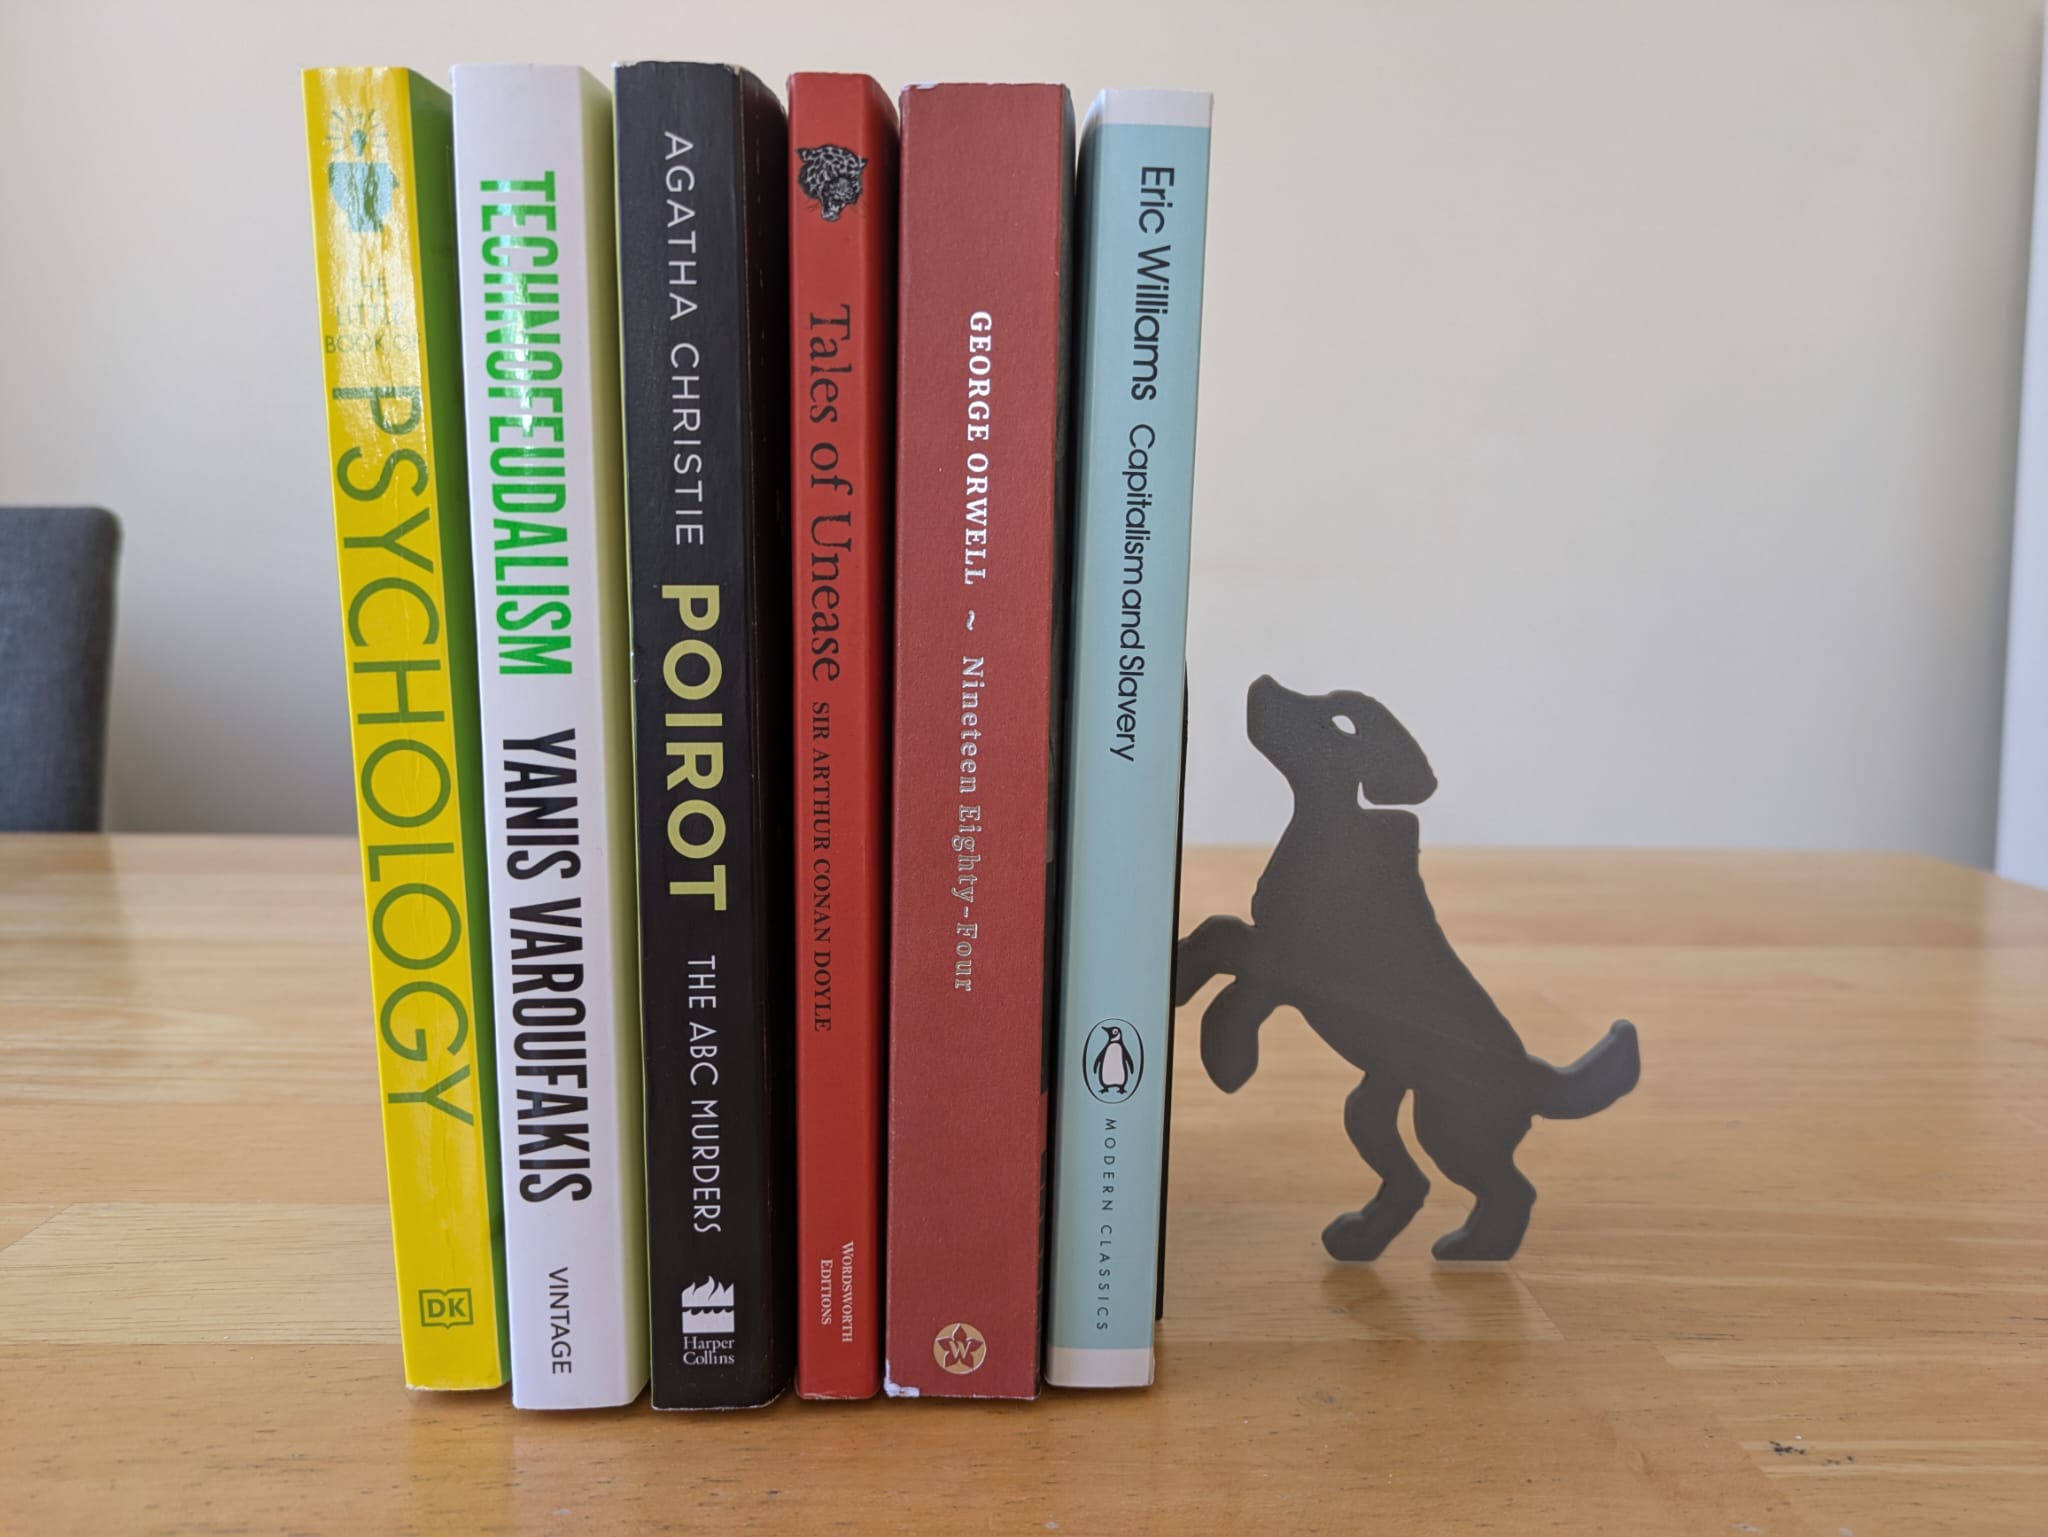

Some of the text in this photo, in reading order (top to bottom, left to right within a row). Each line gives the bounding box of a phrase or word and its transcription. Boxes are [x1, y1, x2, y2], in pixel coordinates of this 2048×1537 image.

[325, 335, 386, 353] BOOK
[664, 131, 704, 546] AGATHA CHRISTIE
[966, 310, 993, 441] GEORGE
[479, 170, 573, 675] TECHNOFEUDALISM
[809, 304, 853, 682] Tales of Unease
[1109, 165, 1176, 762] Eric Williams Capitalism and Slavery
[963, 452, 990, 586] ORWELL
[332, 385, 474, 1127] PSYCHOLOGY
[661, 584, 728, 911] POIROT
[958, 655, 985, 795] Nineteen
[811, 701, 833, 1033] SIR ARTHUR CONAN DOYLE
[950, 804, 982, 993] Eighty-Four
[502, 727, 593, 1204] YANIS VAROUFAKIS
[687, 954, 721, 1234] THE ABC MURDERS
[820, 1258, 834, 1326] EDITIONS
[841, 1240, 855, 1344] WORDSWORTH
[1096, 1117, 1118, 1331] MODERN CLASSICS
[426, 1297, 467, 1319] DK
[548, 1266, 573, 1375] VINTAGE
[682, 1349, 736, 1366] Collins
[683, 1335, 736, 1354] Harper
[949, 1339, 971, 1360] W
